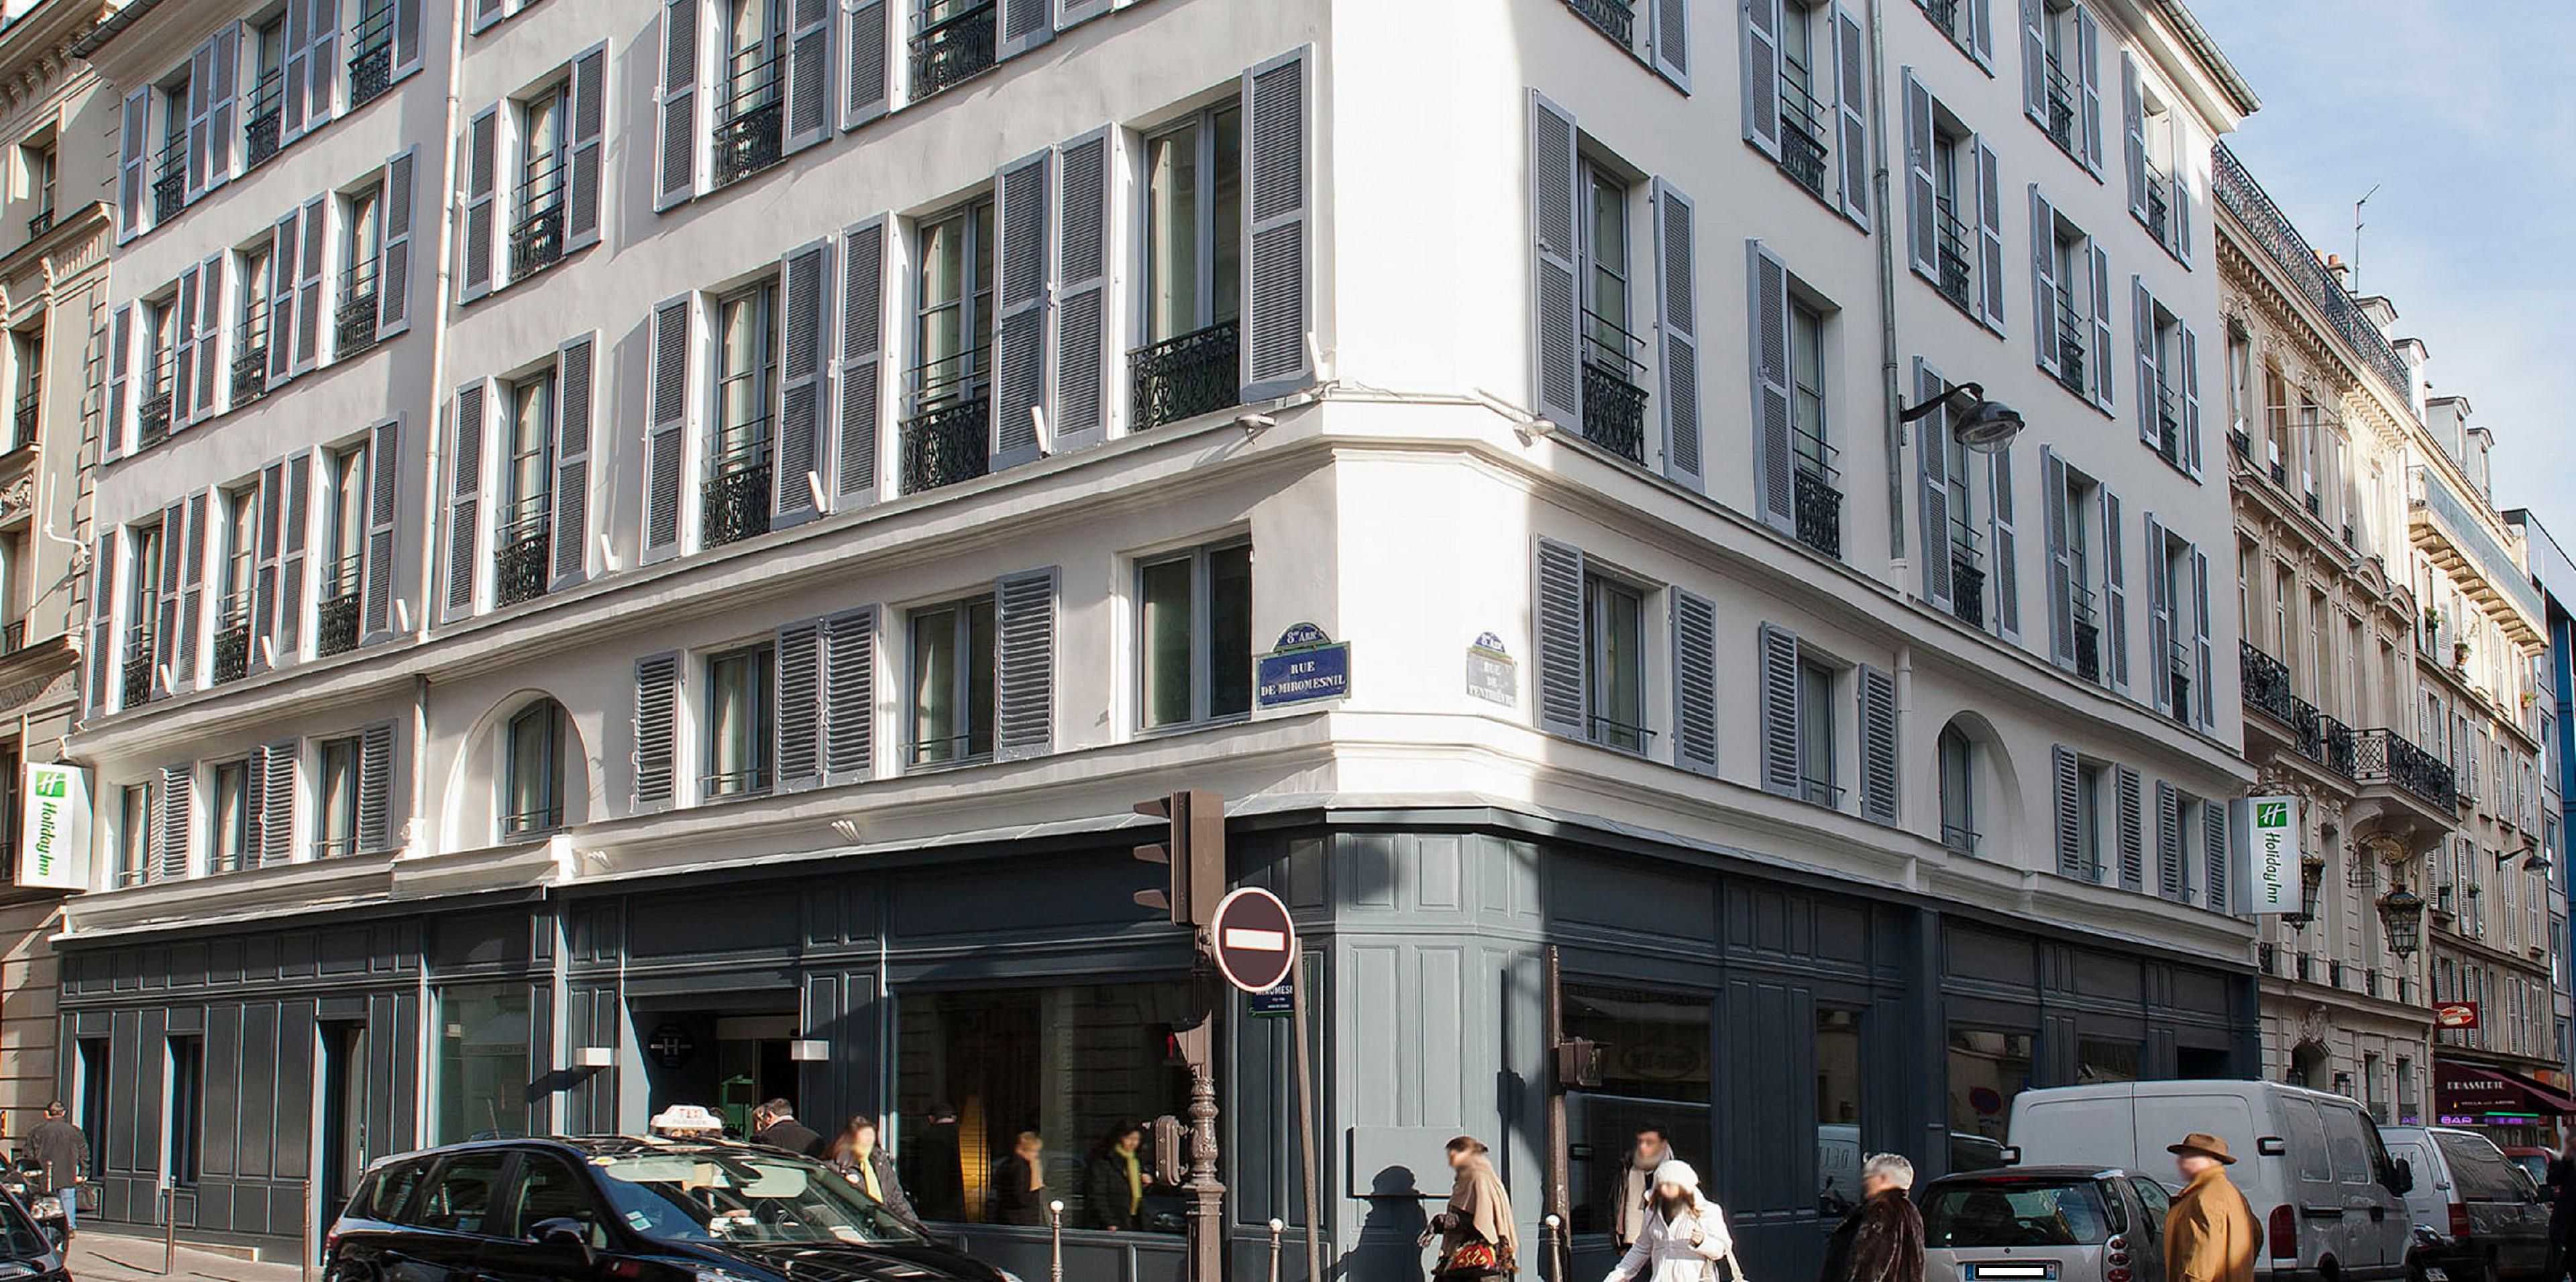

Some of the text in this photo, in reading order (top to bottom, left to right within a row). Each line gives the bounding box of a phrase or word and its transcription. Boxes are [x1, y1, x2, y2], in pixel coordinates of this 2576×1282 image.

[1291, 661, 1316, 675] RUE
[1483, 661, 1501, 676] RUE
[1260, 675, 1346, 696] DE MIROMESNIL
[36, 801, 57, 876] Holiday Inn
[2263, 833, 2282, 904] Holiday Inn
[2440, 1116, 2473, 1125] BAR
